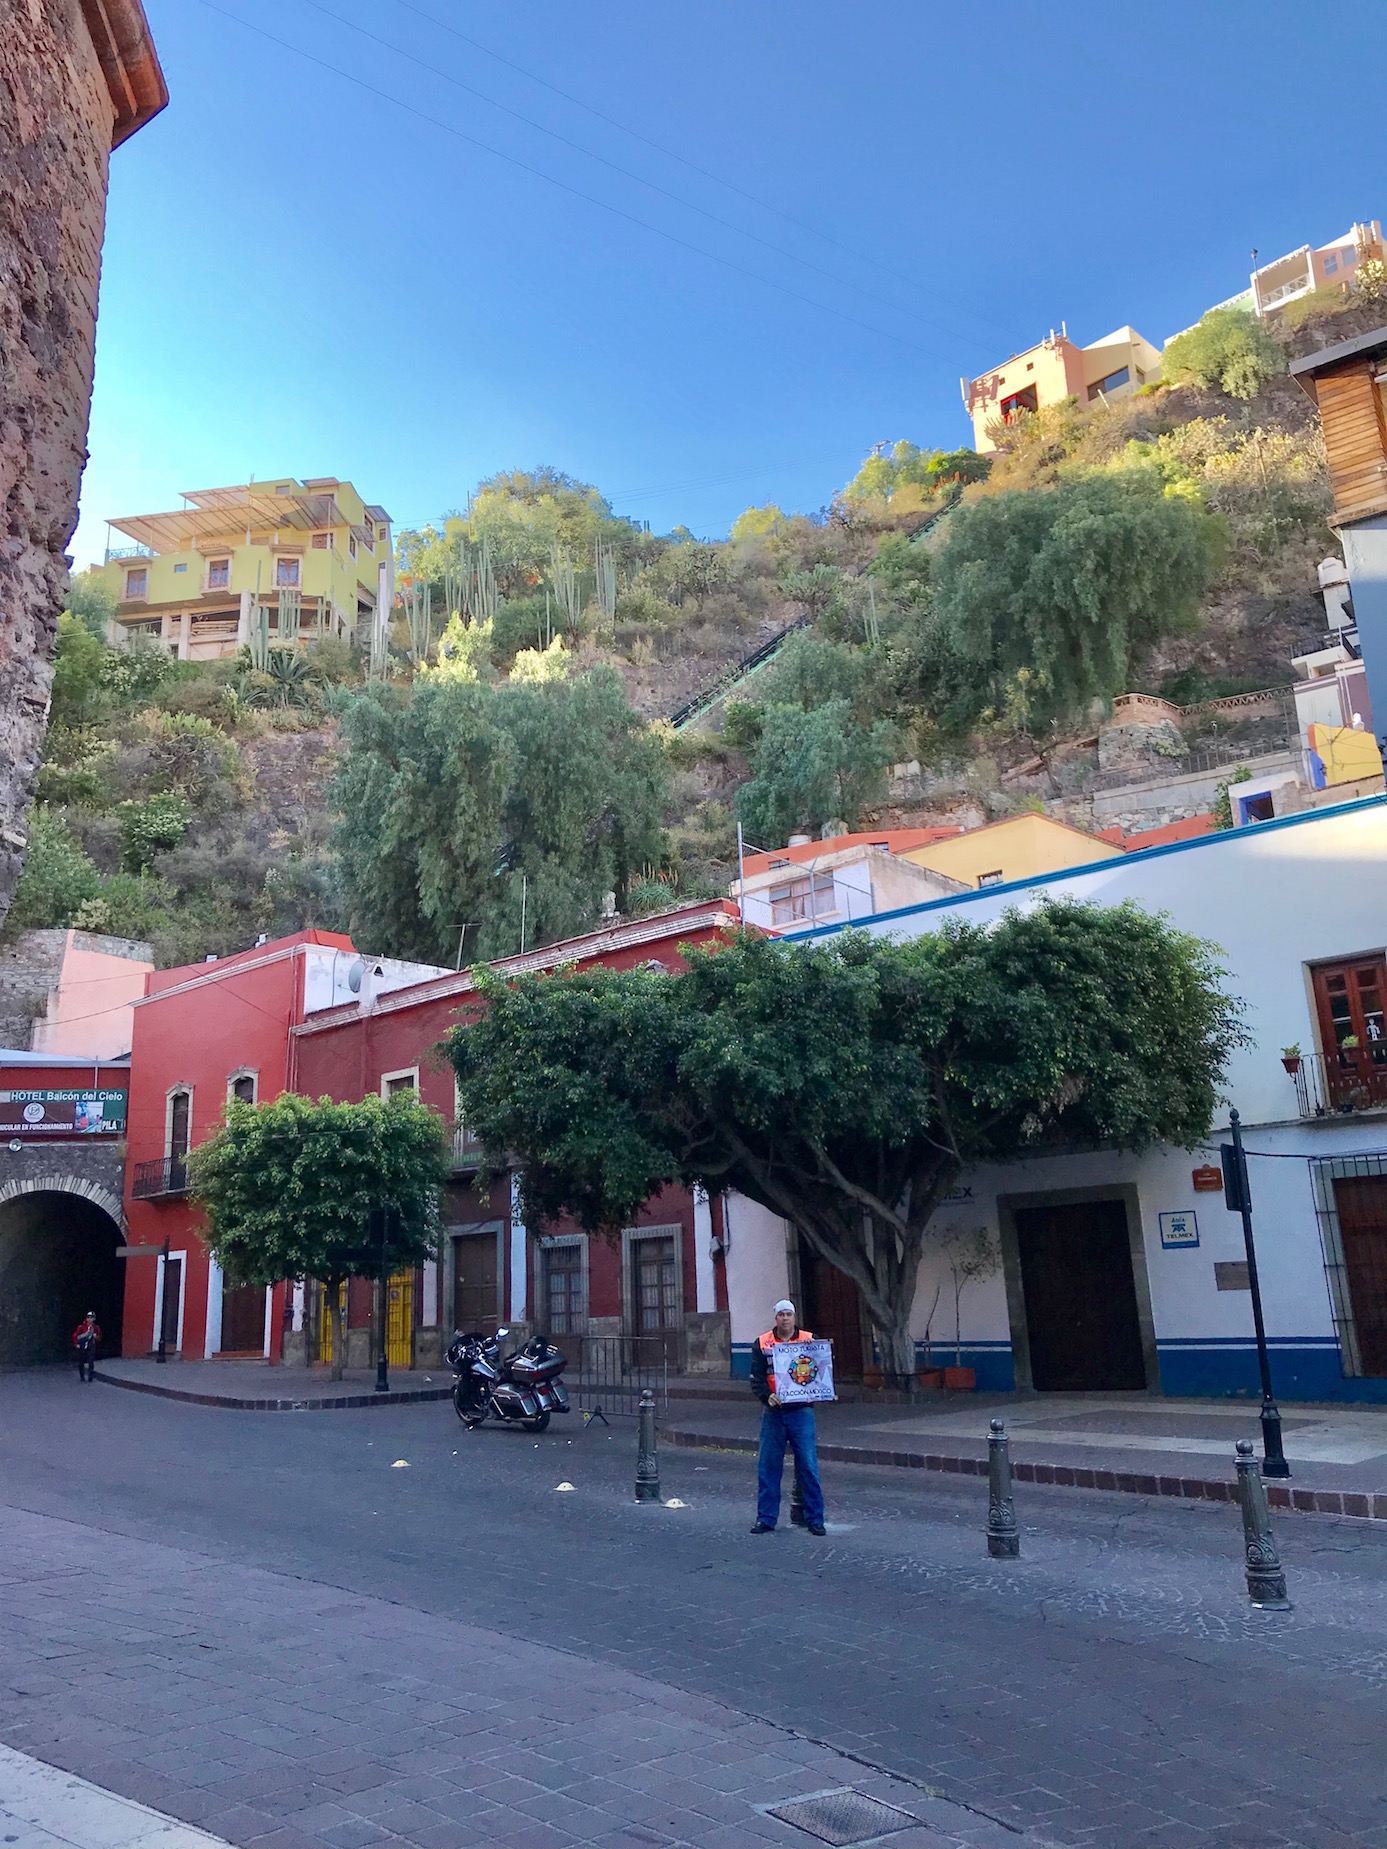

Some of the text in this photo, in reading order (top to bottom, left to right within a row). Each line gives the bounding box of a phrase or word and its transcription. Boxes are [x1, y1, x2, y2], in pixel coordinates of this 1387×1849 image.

[11, 1091, 123, 1101] HOTEL Balcón del Cielo
